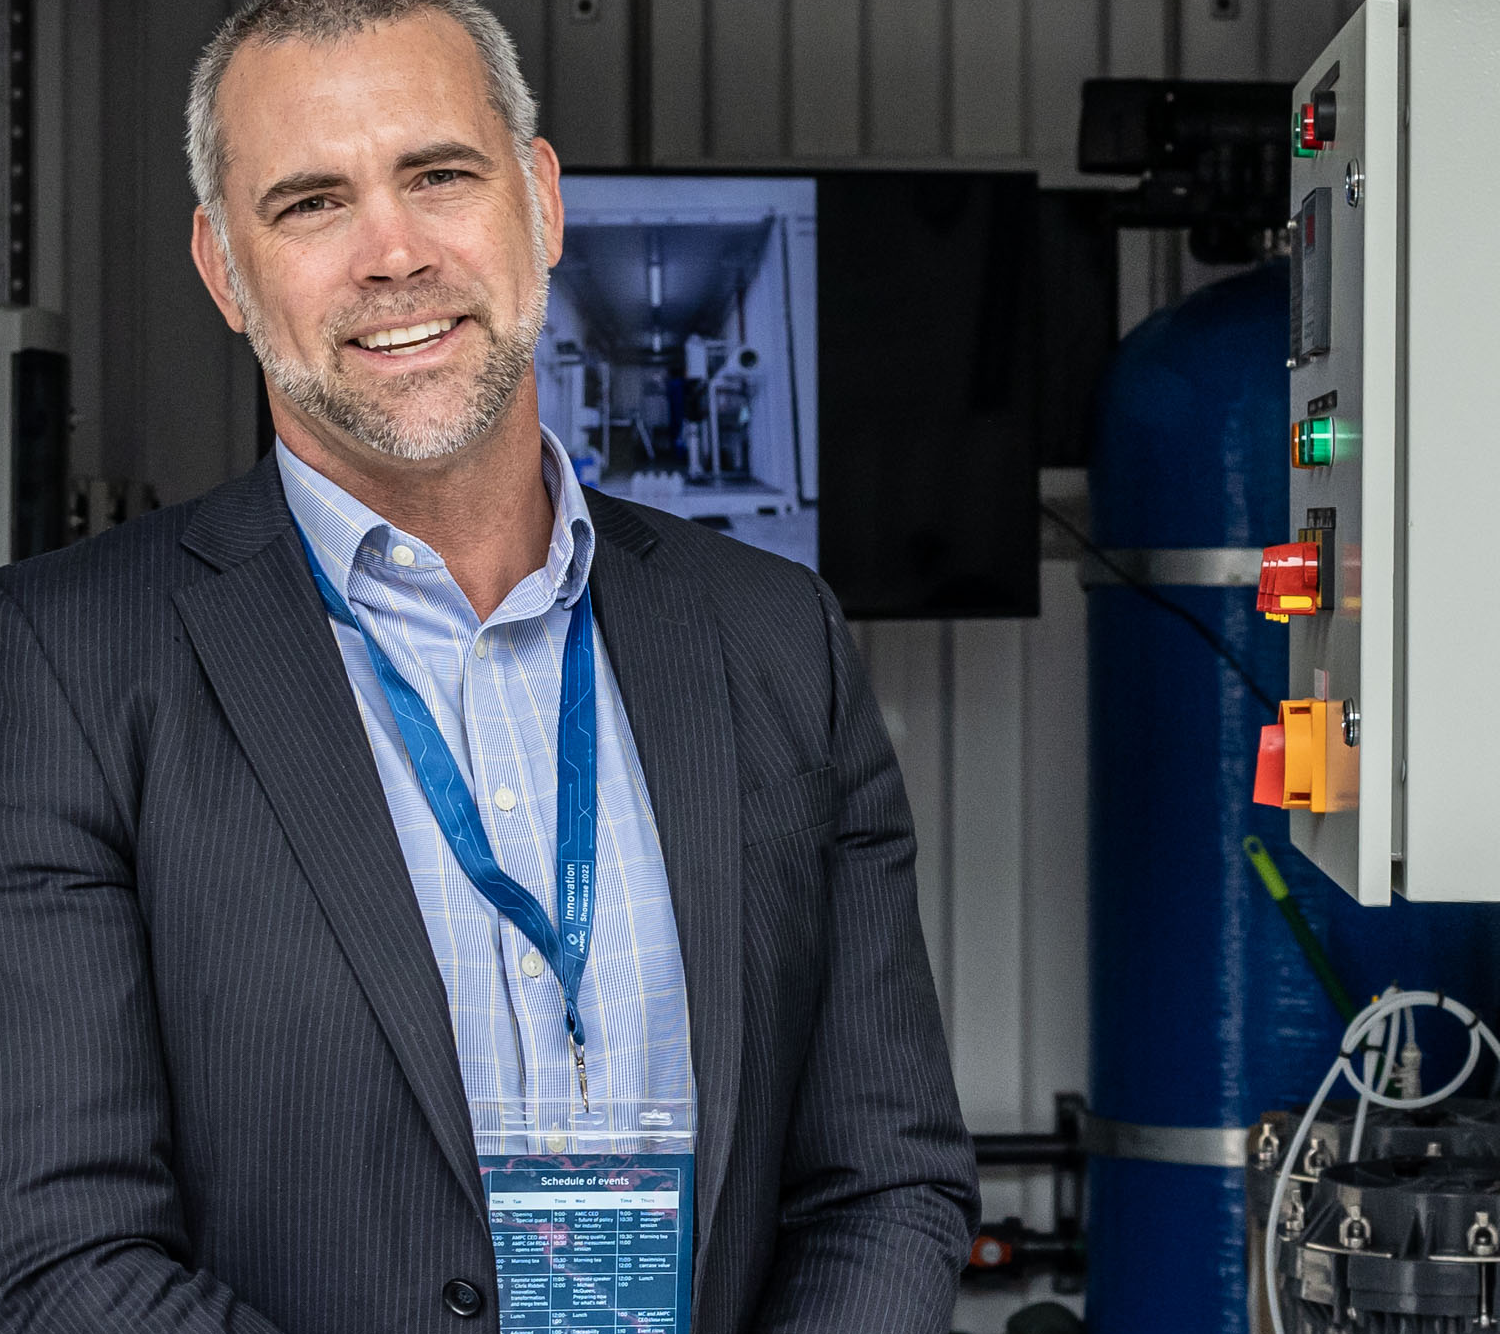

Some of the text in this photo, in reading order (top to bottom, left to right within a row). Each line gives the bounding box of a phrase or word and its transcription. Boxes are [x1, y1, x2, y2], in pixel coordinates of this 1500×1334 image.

[565, 863, 576, 921] Innovation
[580, 885, 589, 922] Showcase
[541, 1177, 629, 1186] Schedule of events
